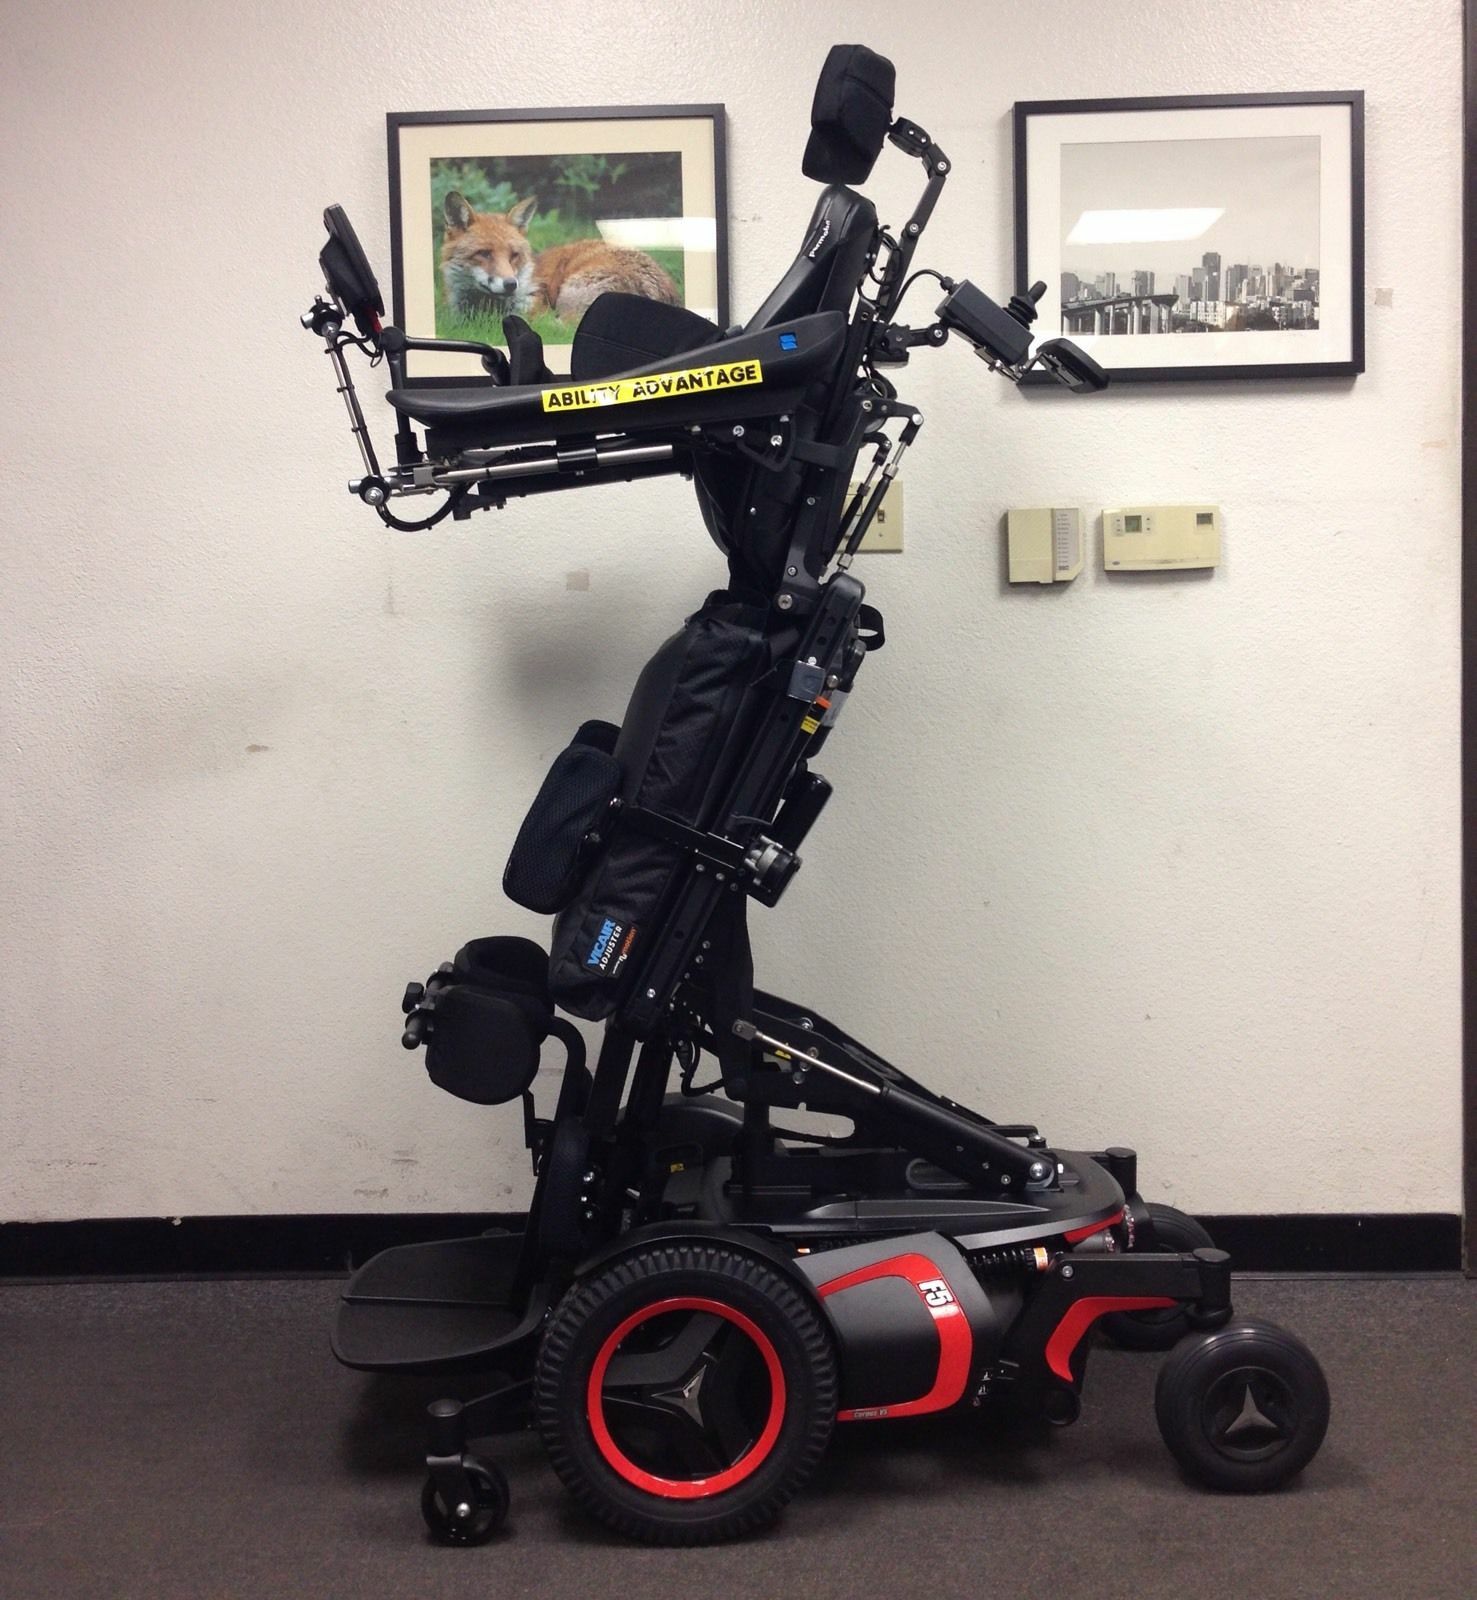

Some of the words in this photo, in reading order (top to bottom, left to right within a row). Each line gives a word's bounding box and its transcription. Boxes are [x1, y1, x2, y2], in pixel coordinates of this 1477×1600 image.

[548, 384, 620, 408] ABILITY
[633, 364, 757, 398] ADVANTAGE
[587, 918, 616, 965] VICAIR
[599, 925, 623, 970] ADJUSTER
[917, 1278, 955, 1308] F5
